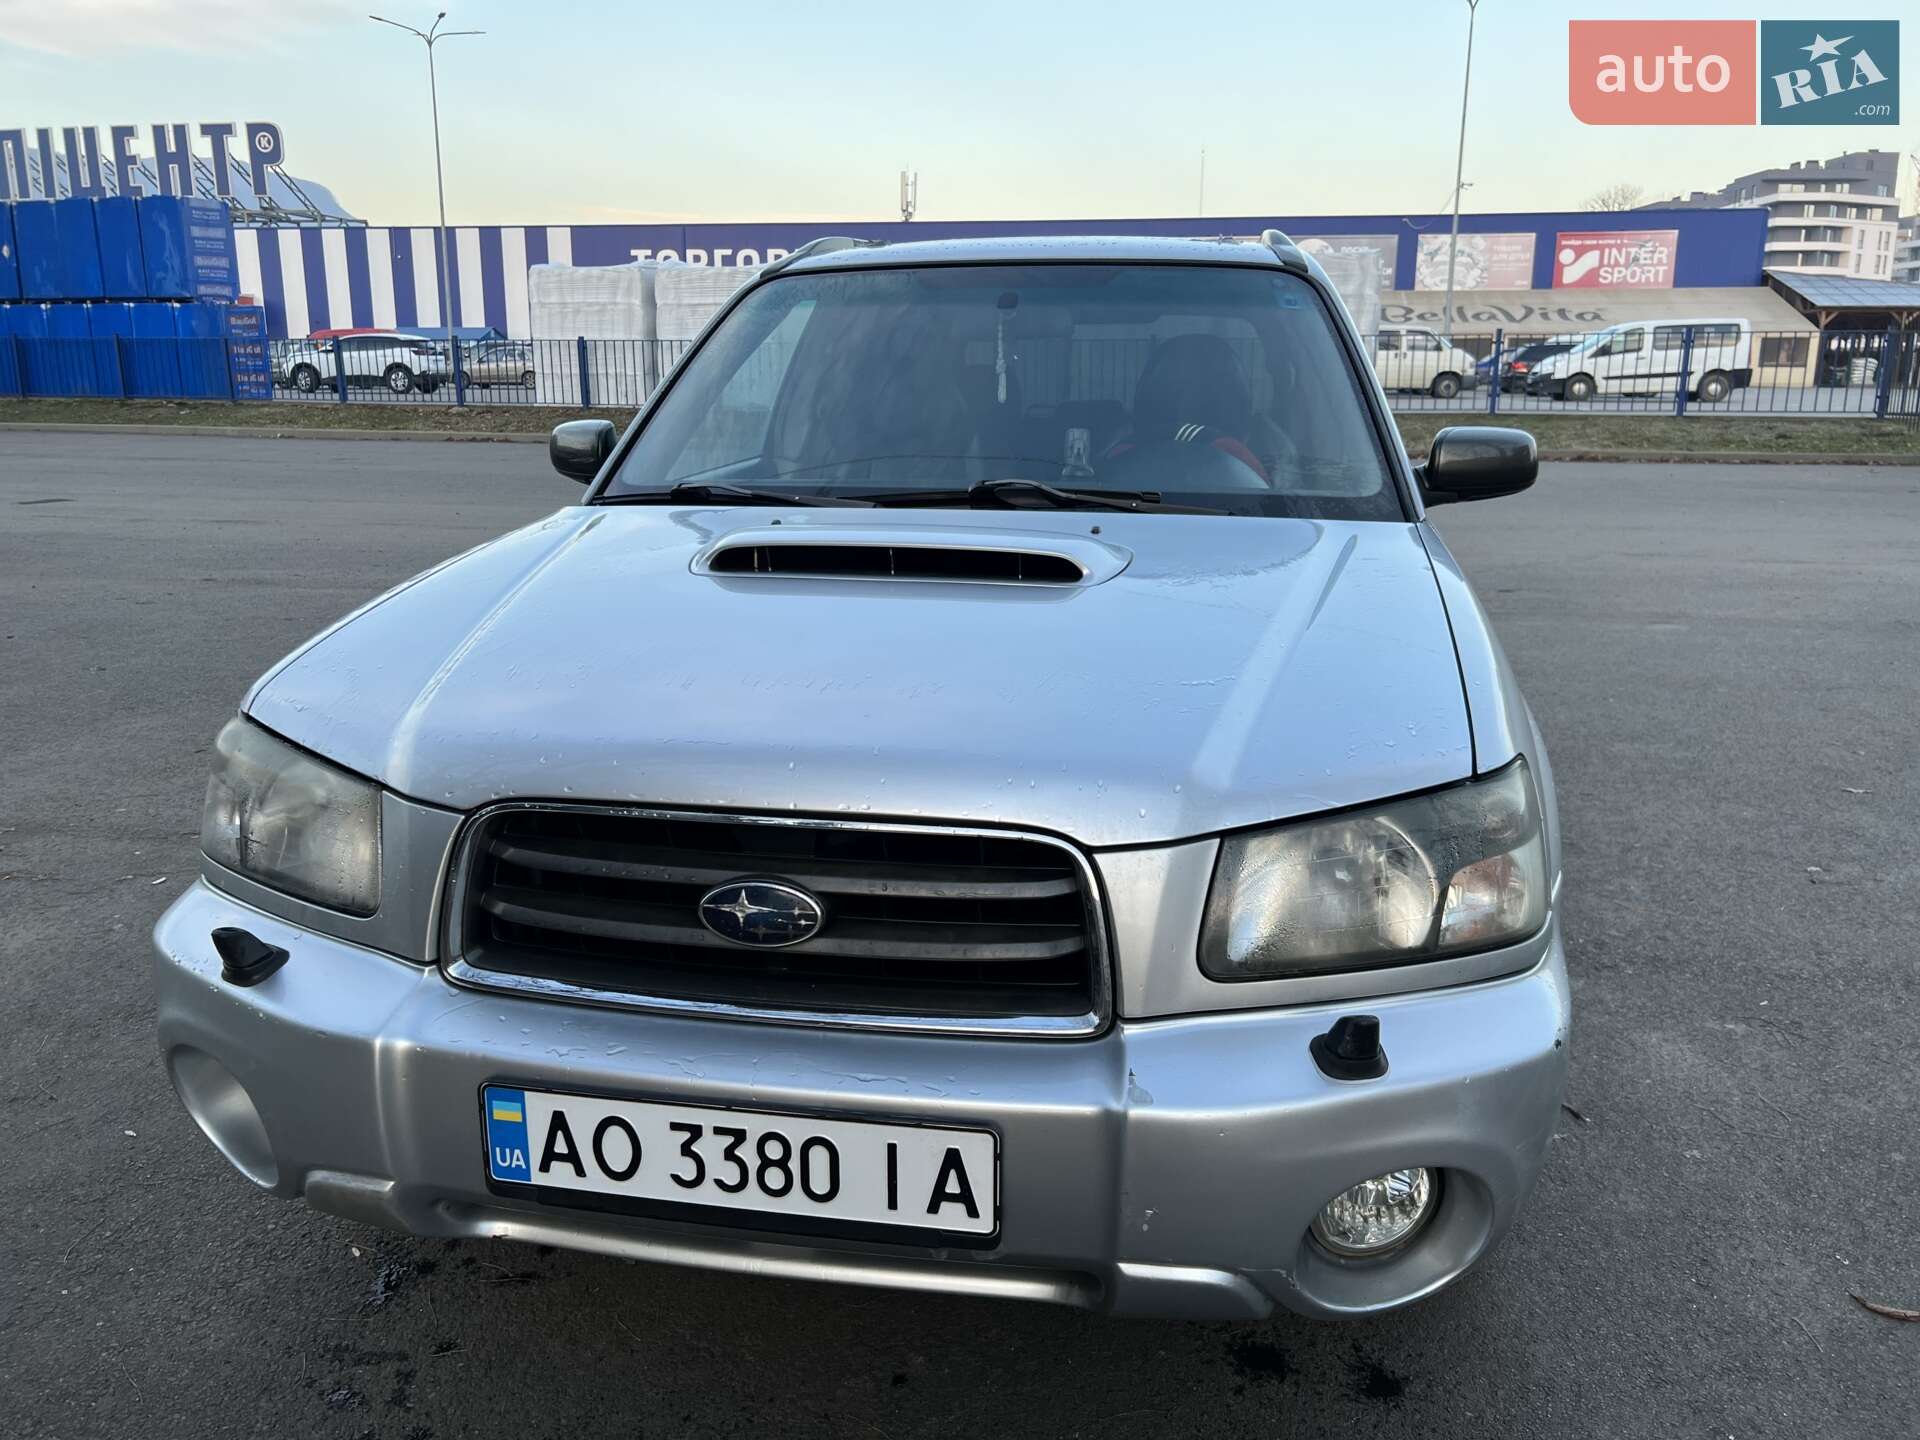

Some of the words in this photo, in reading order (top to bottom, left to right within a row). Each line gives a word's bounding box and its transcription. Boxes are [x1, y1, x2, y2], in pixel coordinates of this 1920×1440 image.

[1603, 247, 1669, 266] INTER
[1598, 265, 1668, 284] SPORT
[495, 1146, 527, 1170] UA
[538, 1109, 643, 1182] AO
[669, 1121, 840, 1203] 3380
